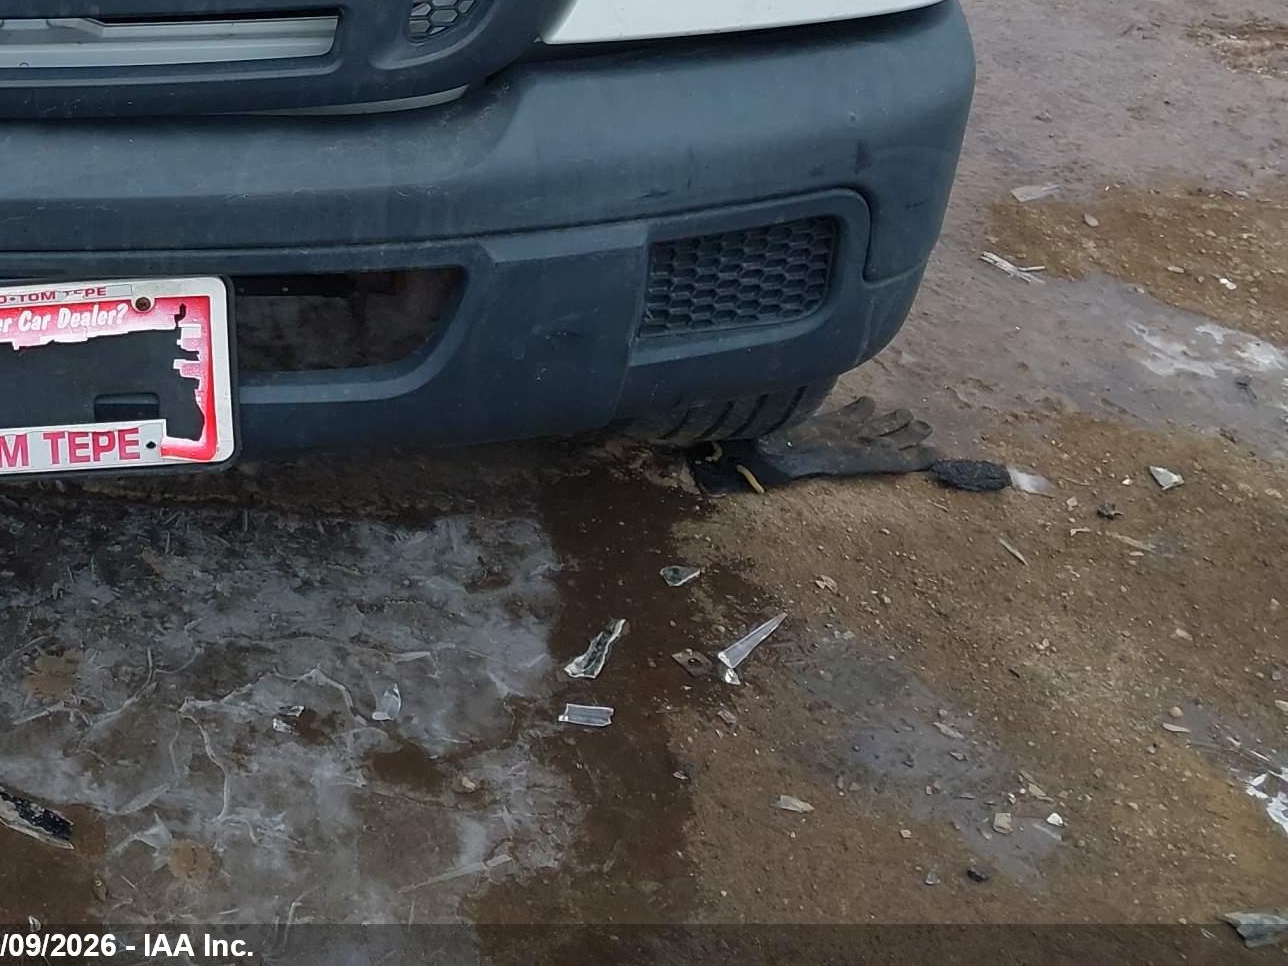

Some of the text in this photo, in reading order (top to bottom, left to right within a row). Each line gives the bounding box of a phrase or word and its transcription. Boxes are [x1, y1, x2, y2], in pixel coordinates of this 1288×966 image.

[19, 309, 51, 332] Car
[57, 304, 127, 328] Dealer?
[43, 427, 140, 464] TEPE
